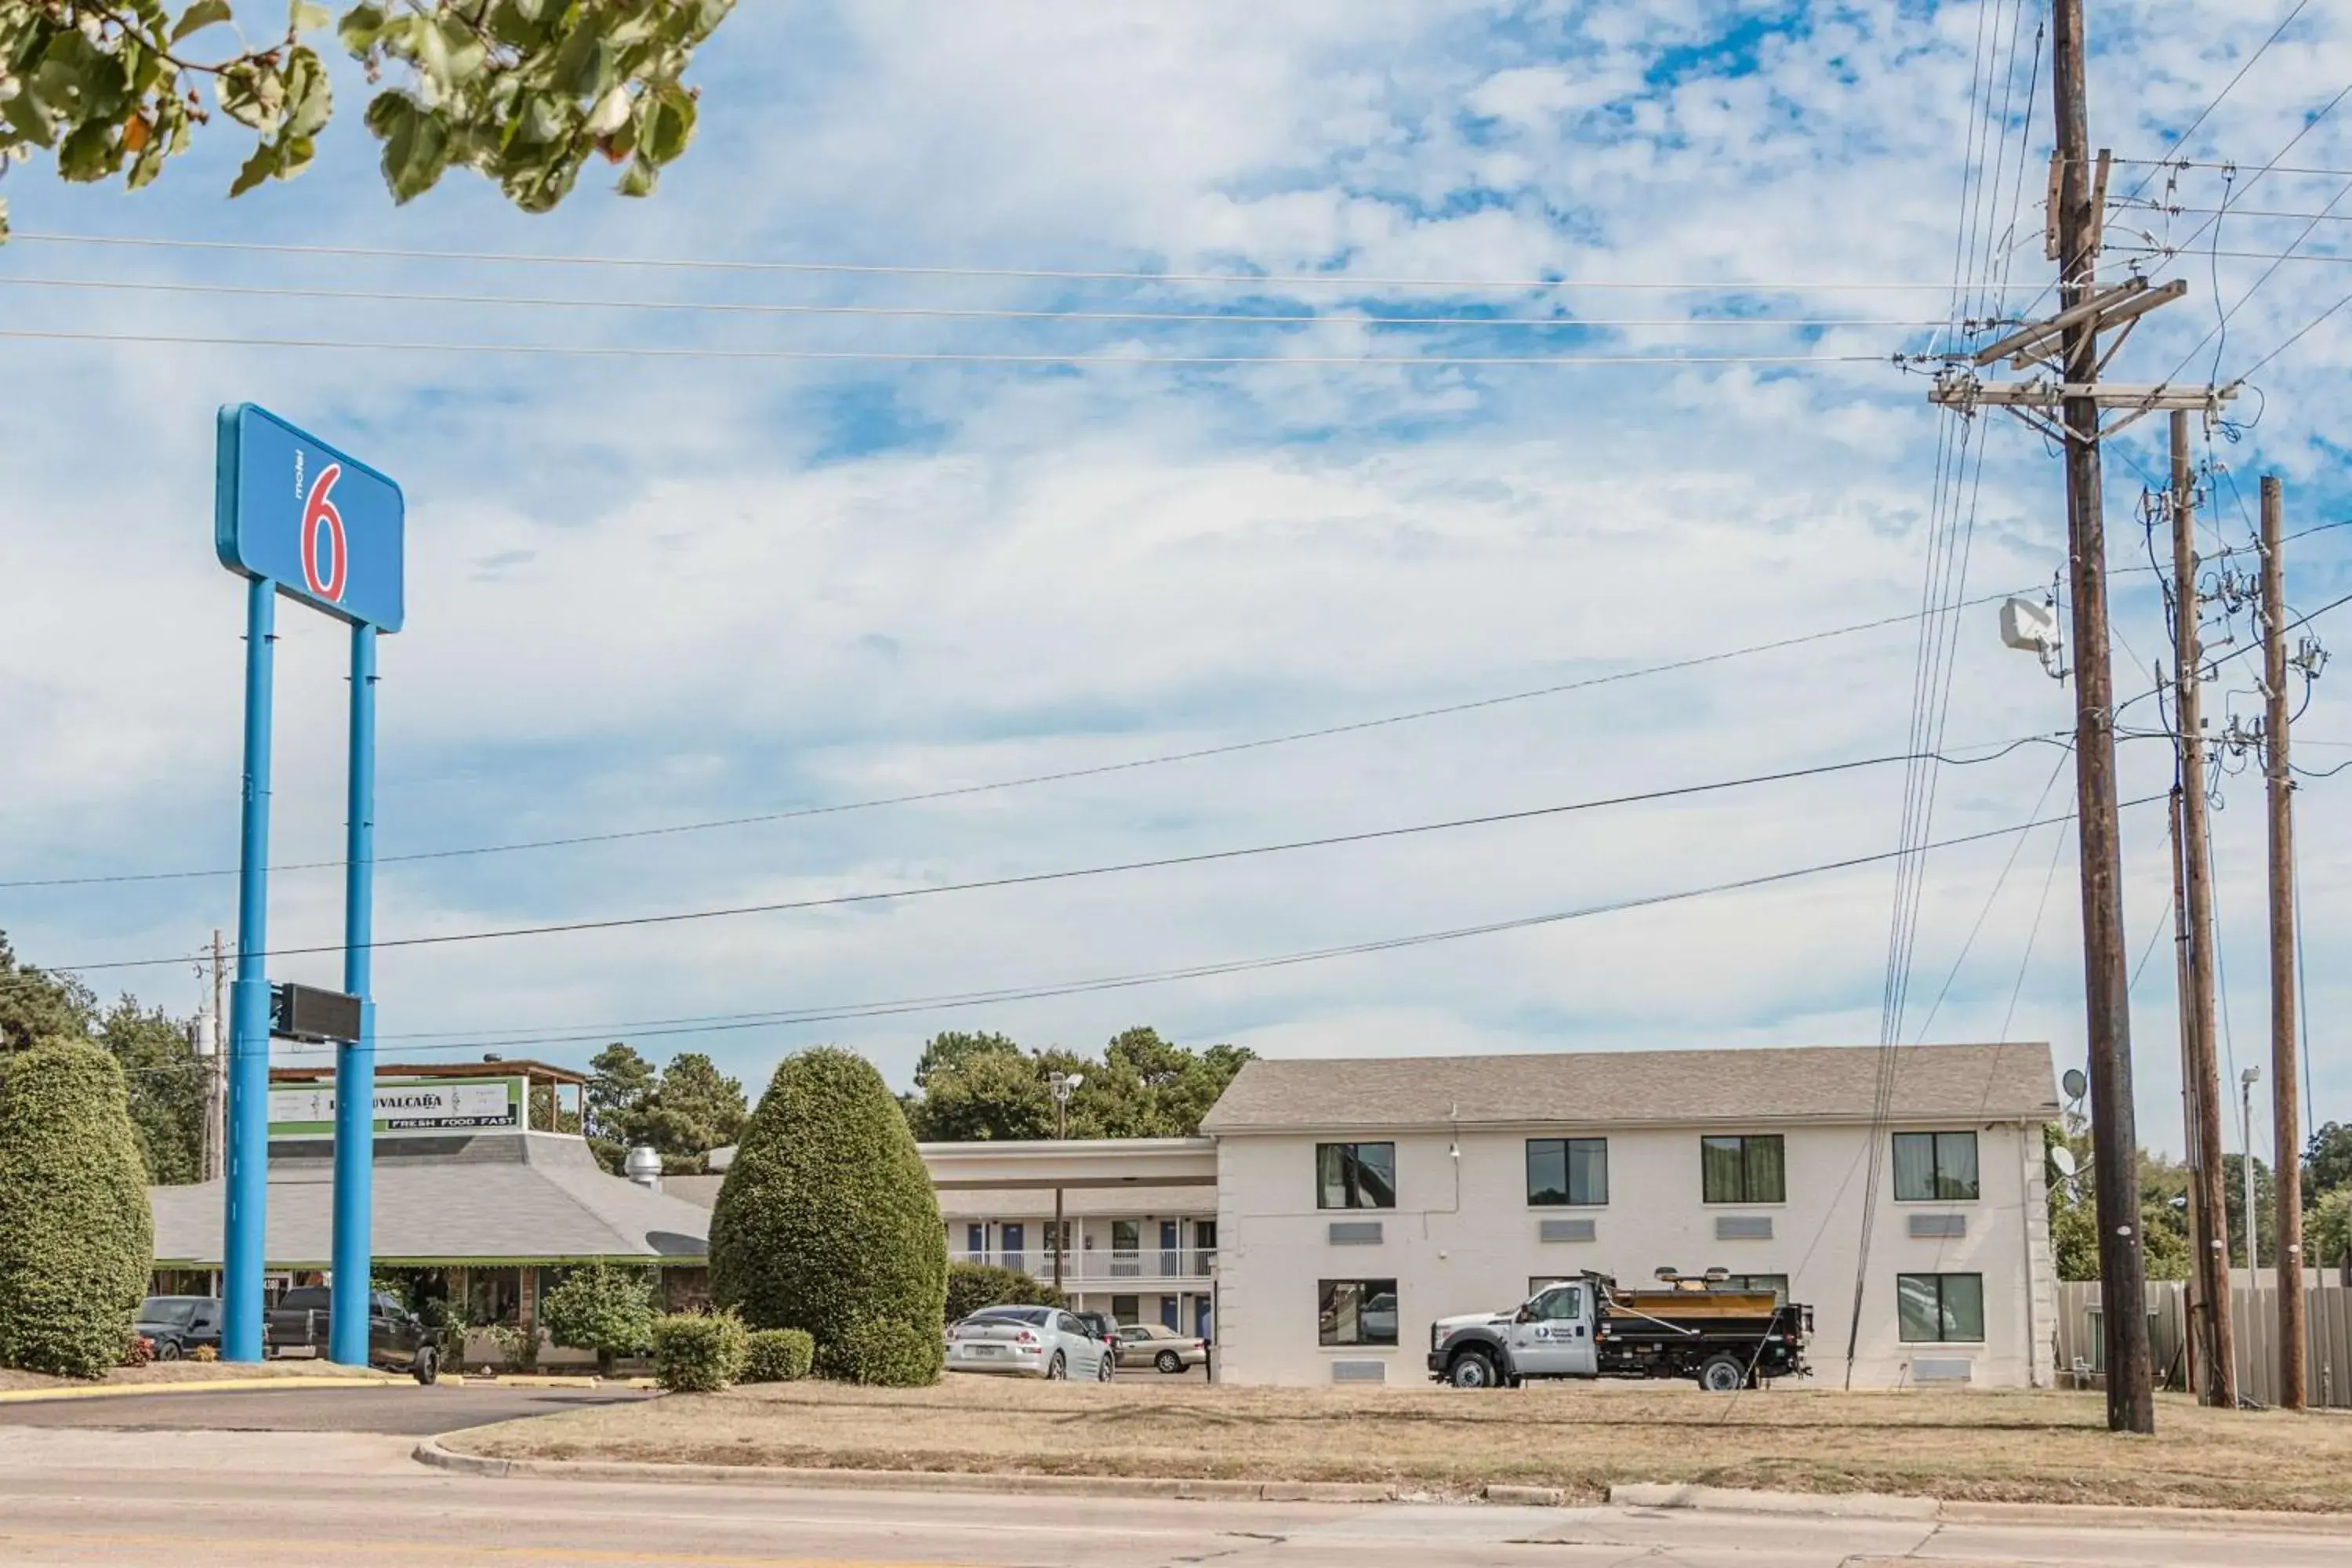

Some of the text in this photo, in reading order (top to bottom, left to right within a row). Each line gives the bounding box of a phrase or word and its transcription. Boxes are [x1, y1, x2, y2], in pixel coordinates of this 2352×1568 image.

[300, 463, 348, 603] 6
[393, 1116, 515, 1128] FRESH FOOD FAST
